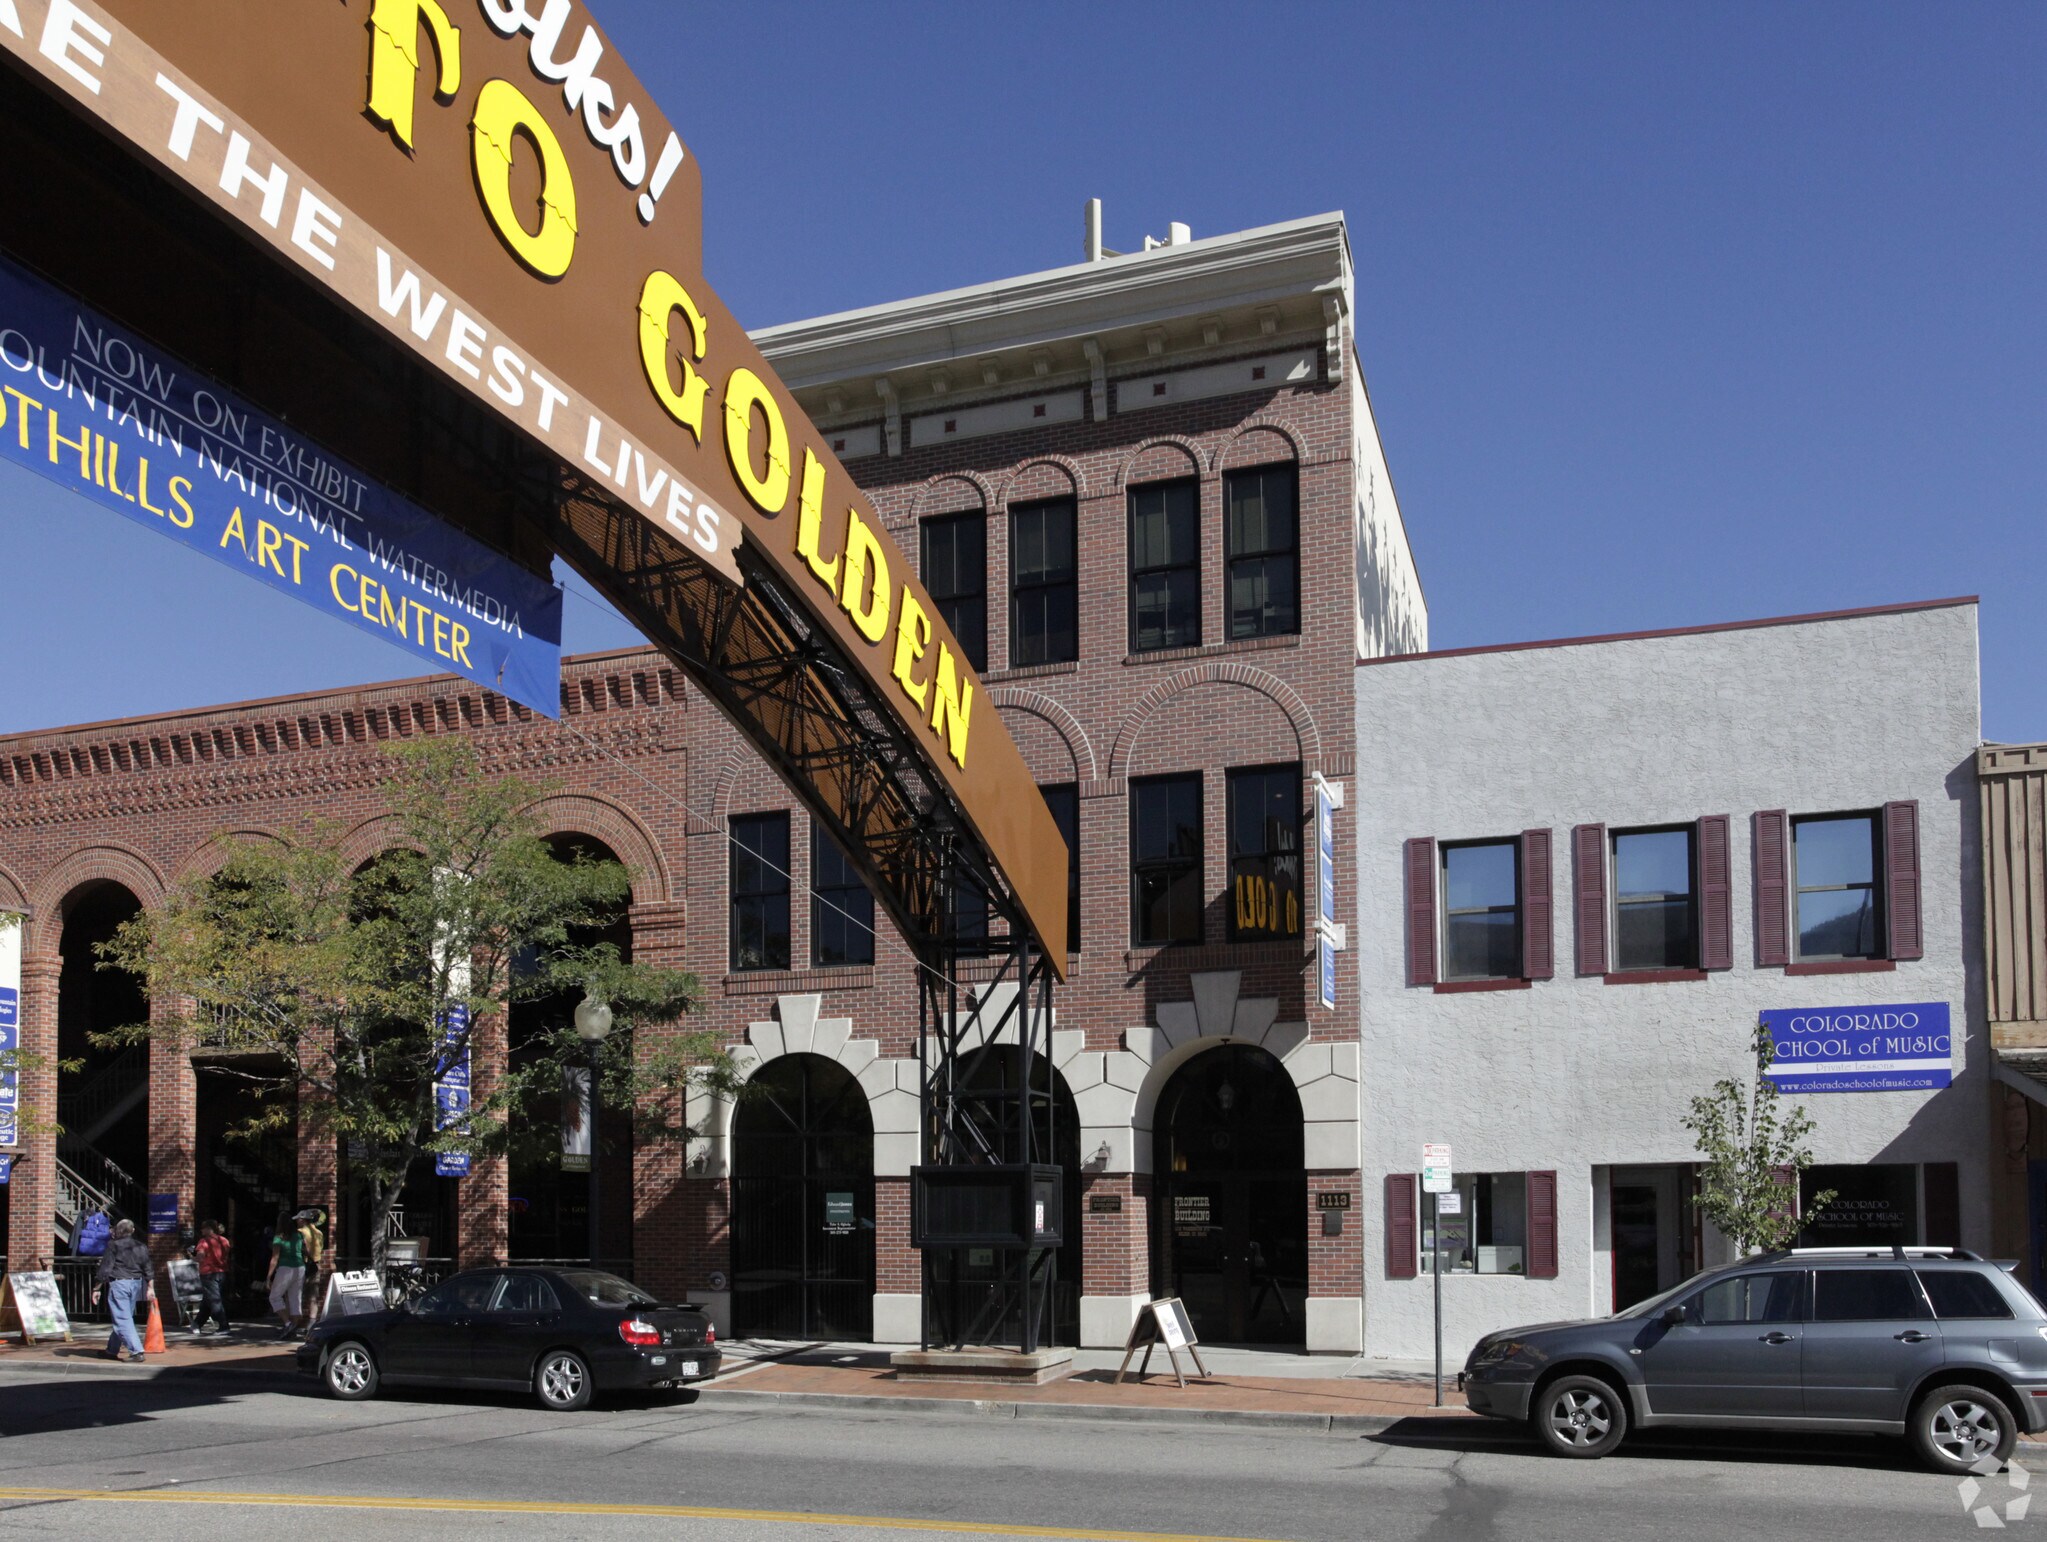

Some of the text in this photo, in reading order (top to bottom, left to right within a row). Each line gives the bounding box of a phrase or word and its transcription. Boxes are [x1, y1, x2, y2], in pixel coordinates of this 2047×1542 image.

[155, 71, 342, 271] THE
[376, 247, 568, 432] WEST
[584, 413, 720, 553] LIVES
[73, 314, 367, 512] NOW ON EXHIBIT
[0, 384, 474, 669] THILLS ART CENTER
[637, 269, 974, 770] GOLDEN
[198, 436, 352, 551] NATIONAL
[368, 531, 523, 640] WATERMEDIA
[1790, 1012, 1919, 1034] COLORADO
[1772, 1034, 1950, 1058] CHOOL of MUSIC
[1816, 1062, 1895, 1072] Private Lessons
[1780, 1077, 1933, 1091] www.coloradoschoolofmusic.com
[562, 1156, 588, 1164] GOLDEN
[1174, 1196, 1210, 1207] FRONTIER
[1321, 1195, 1347, 1206] 1113
[1830, 1200, 1890, 1210] COLORADO
[1174, 1210, 1210, 1221] BUILDING
[1816, 1212, 1858, 1221] SCHOOL
[1875, 1211, 1905, 1221] MUSIC
